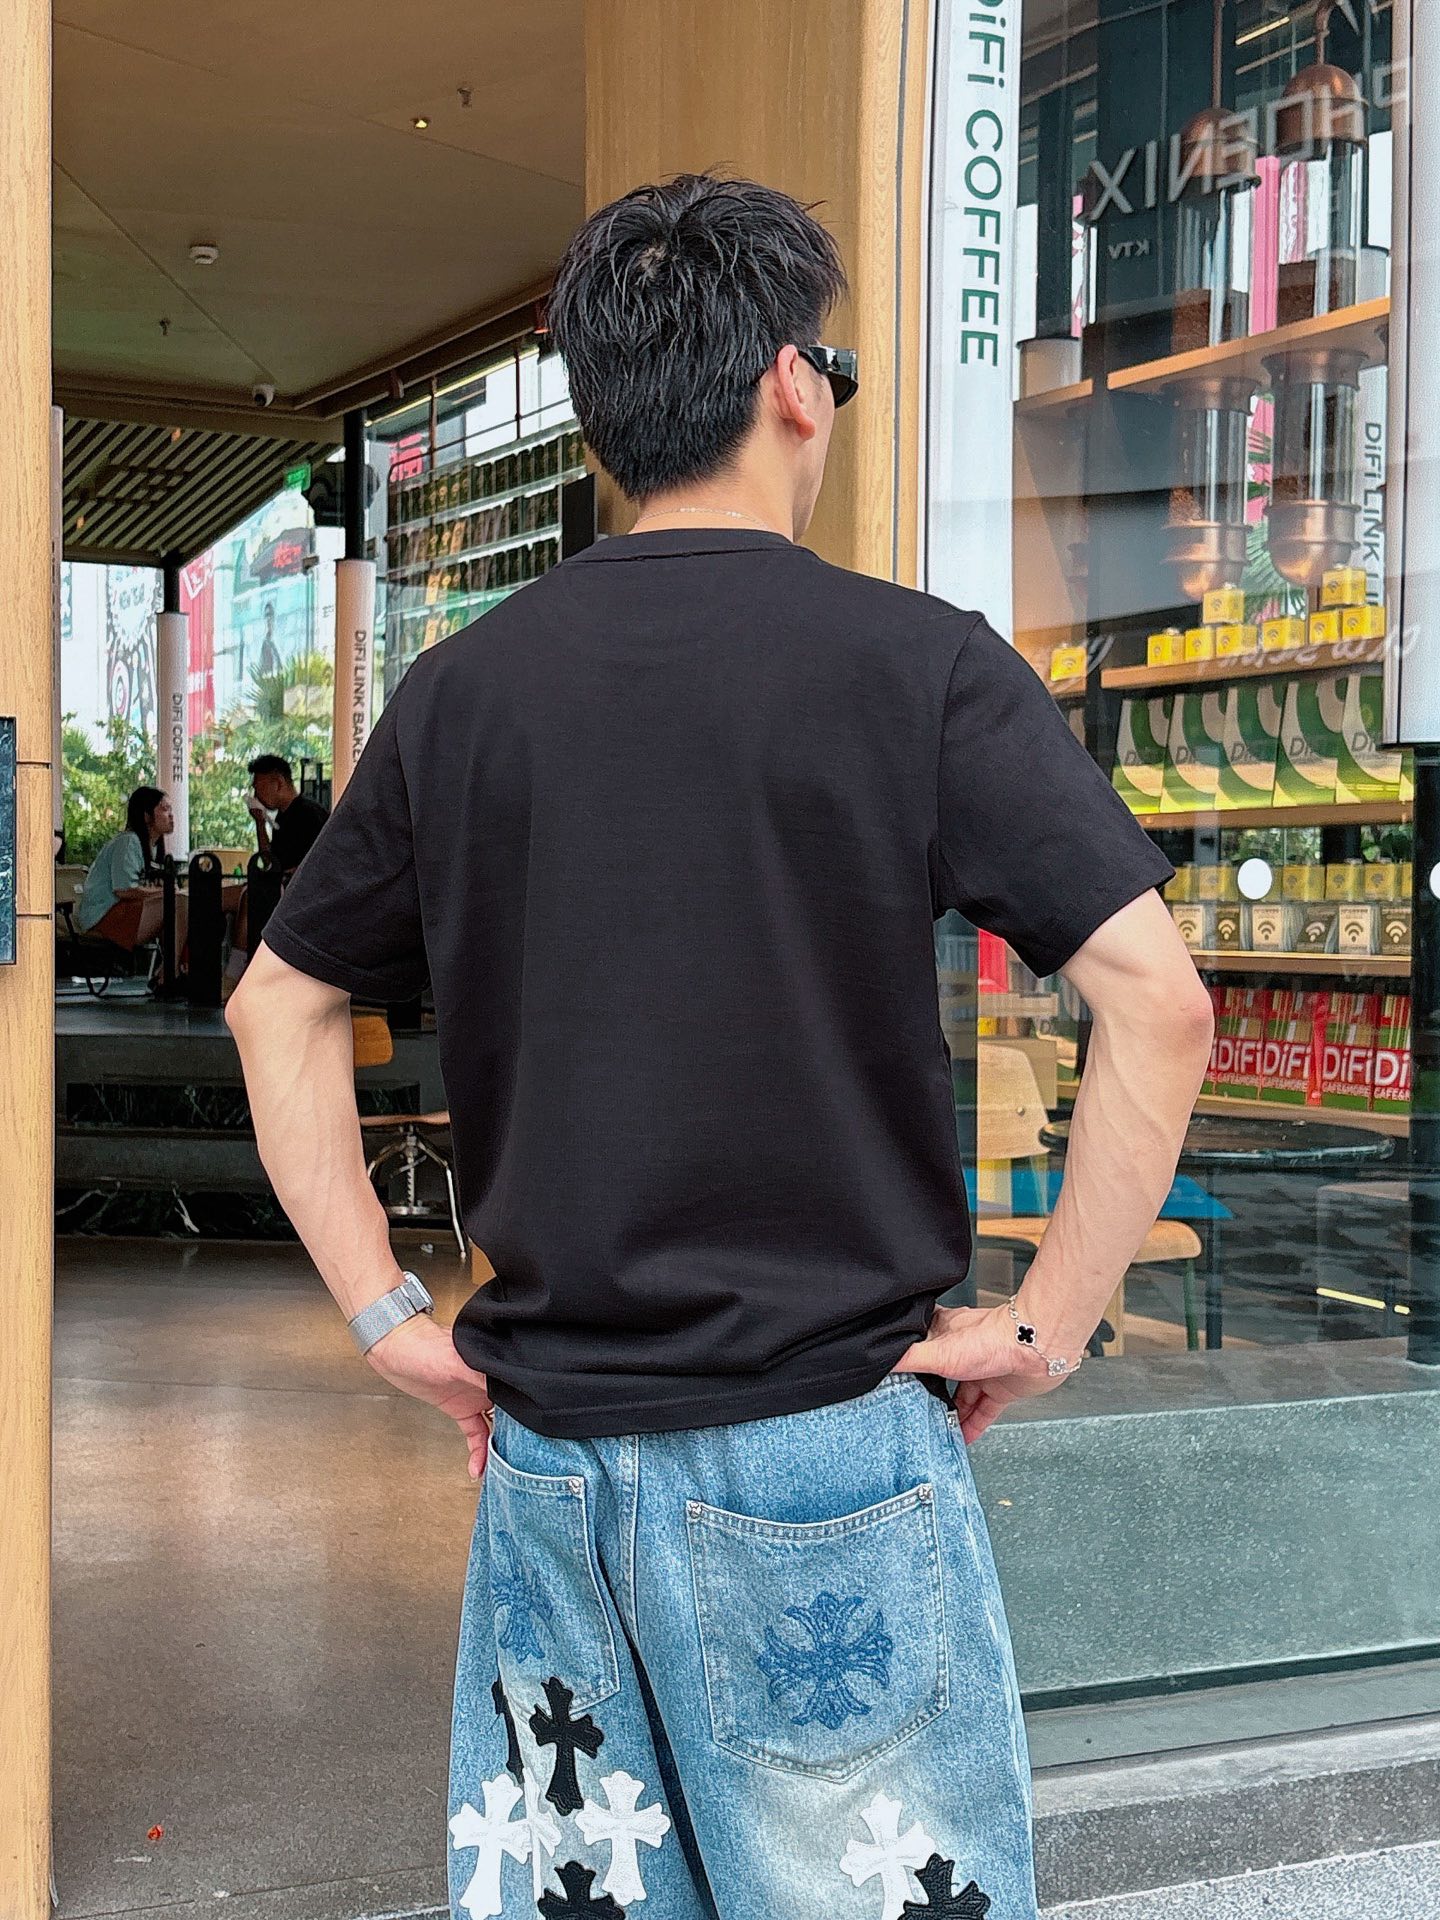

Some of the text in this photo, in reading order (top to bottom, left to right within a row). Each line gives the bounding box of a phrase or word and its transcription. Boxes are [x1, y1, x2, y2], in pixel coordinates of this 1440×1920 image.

[961, 0, 1006, 367] iFi COFFEE
[1364, 422, 1382, 480] DiFi
[1363, 490, 1380, 561] LINK
[353, 666, 366, 707] LINK
[173, 724, 183, 783] COFFEE
[352, 712, 365, 763] BAKE
[1217, 1038, 1262, 1075] DiFi
[1263, 1041, 1311, 1080] DiFi
[1323, 1045, 1373, 1085] DiFi
[1374, 1050, 1410, 1088] Di
